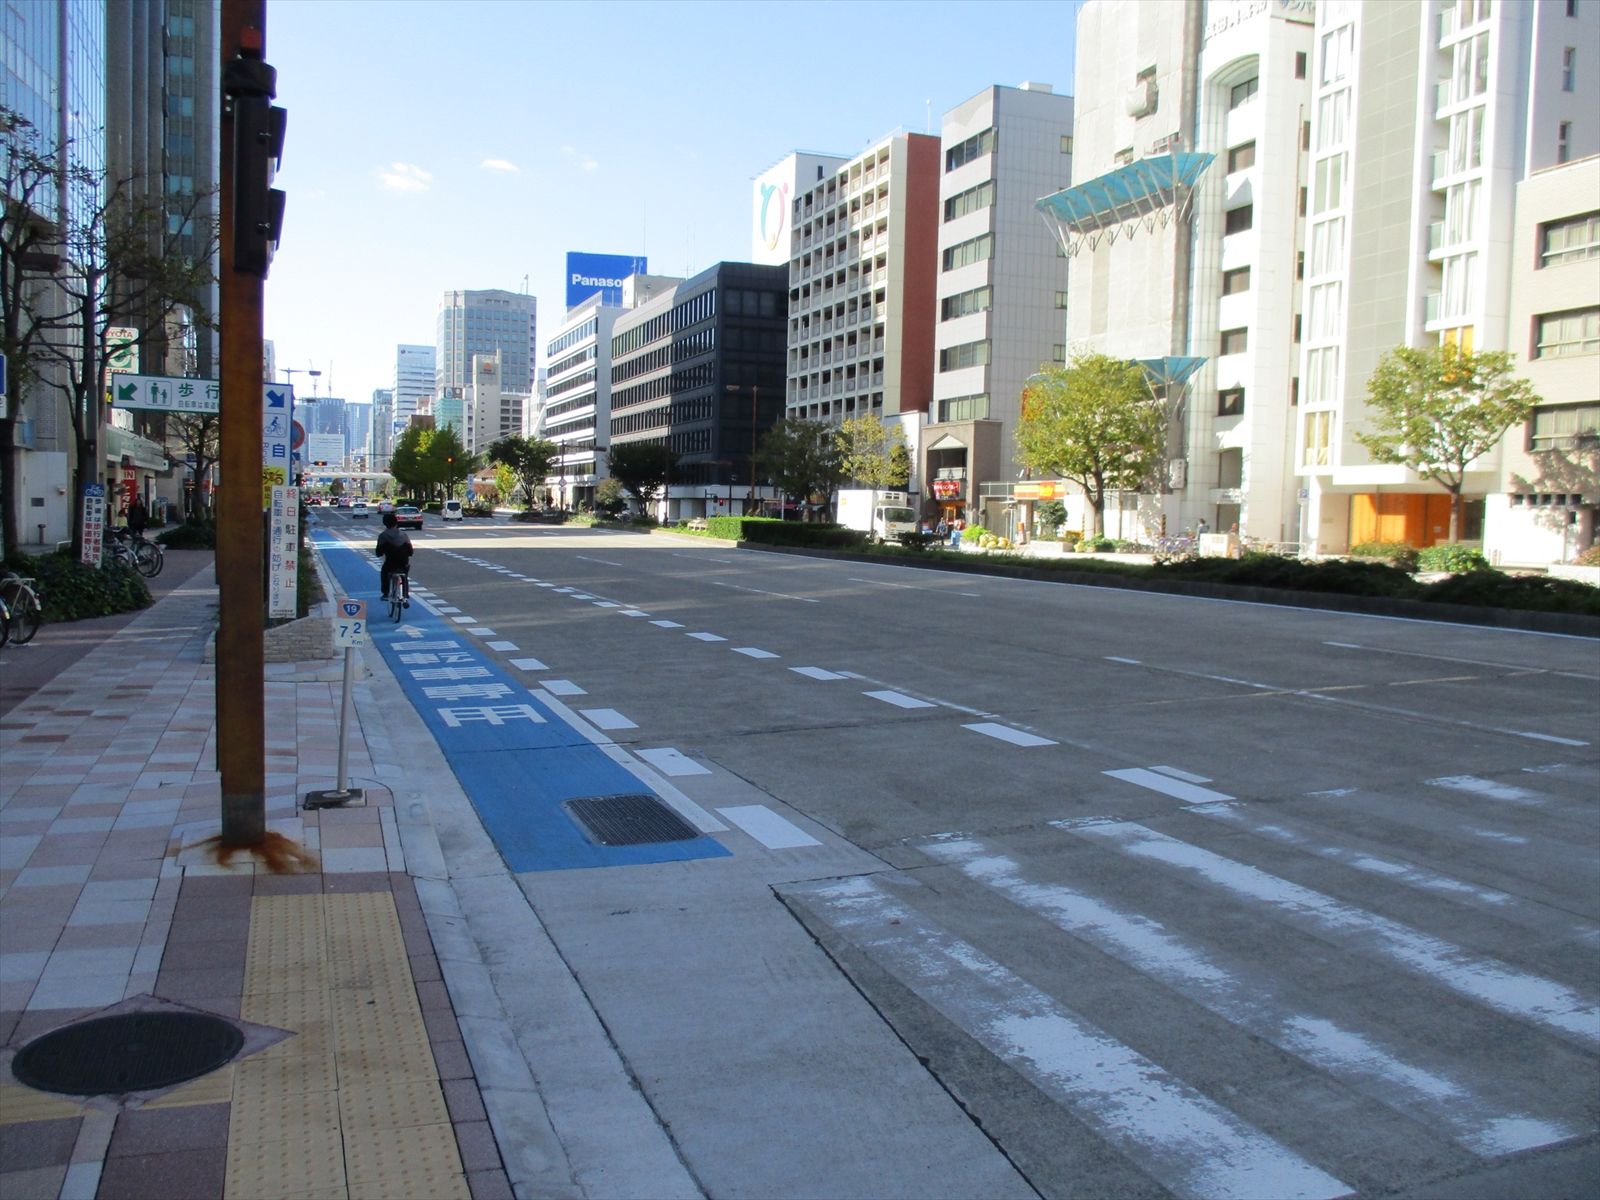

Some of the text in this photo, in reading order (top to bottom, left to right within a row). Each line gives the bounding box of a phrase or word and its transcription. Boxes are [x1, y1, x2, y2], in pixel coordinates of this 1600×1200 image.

[572, 274, 623, 288] Panaso
[178, 400, 219, 409] 自転車は車道
[285, 488, 296, 588] 終日駐車禁止
[346, 605, 357, 613] 19
[340, 622, 361, 638] 7.2
[390, 640, 548, 727] 自転車専用
